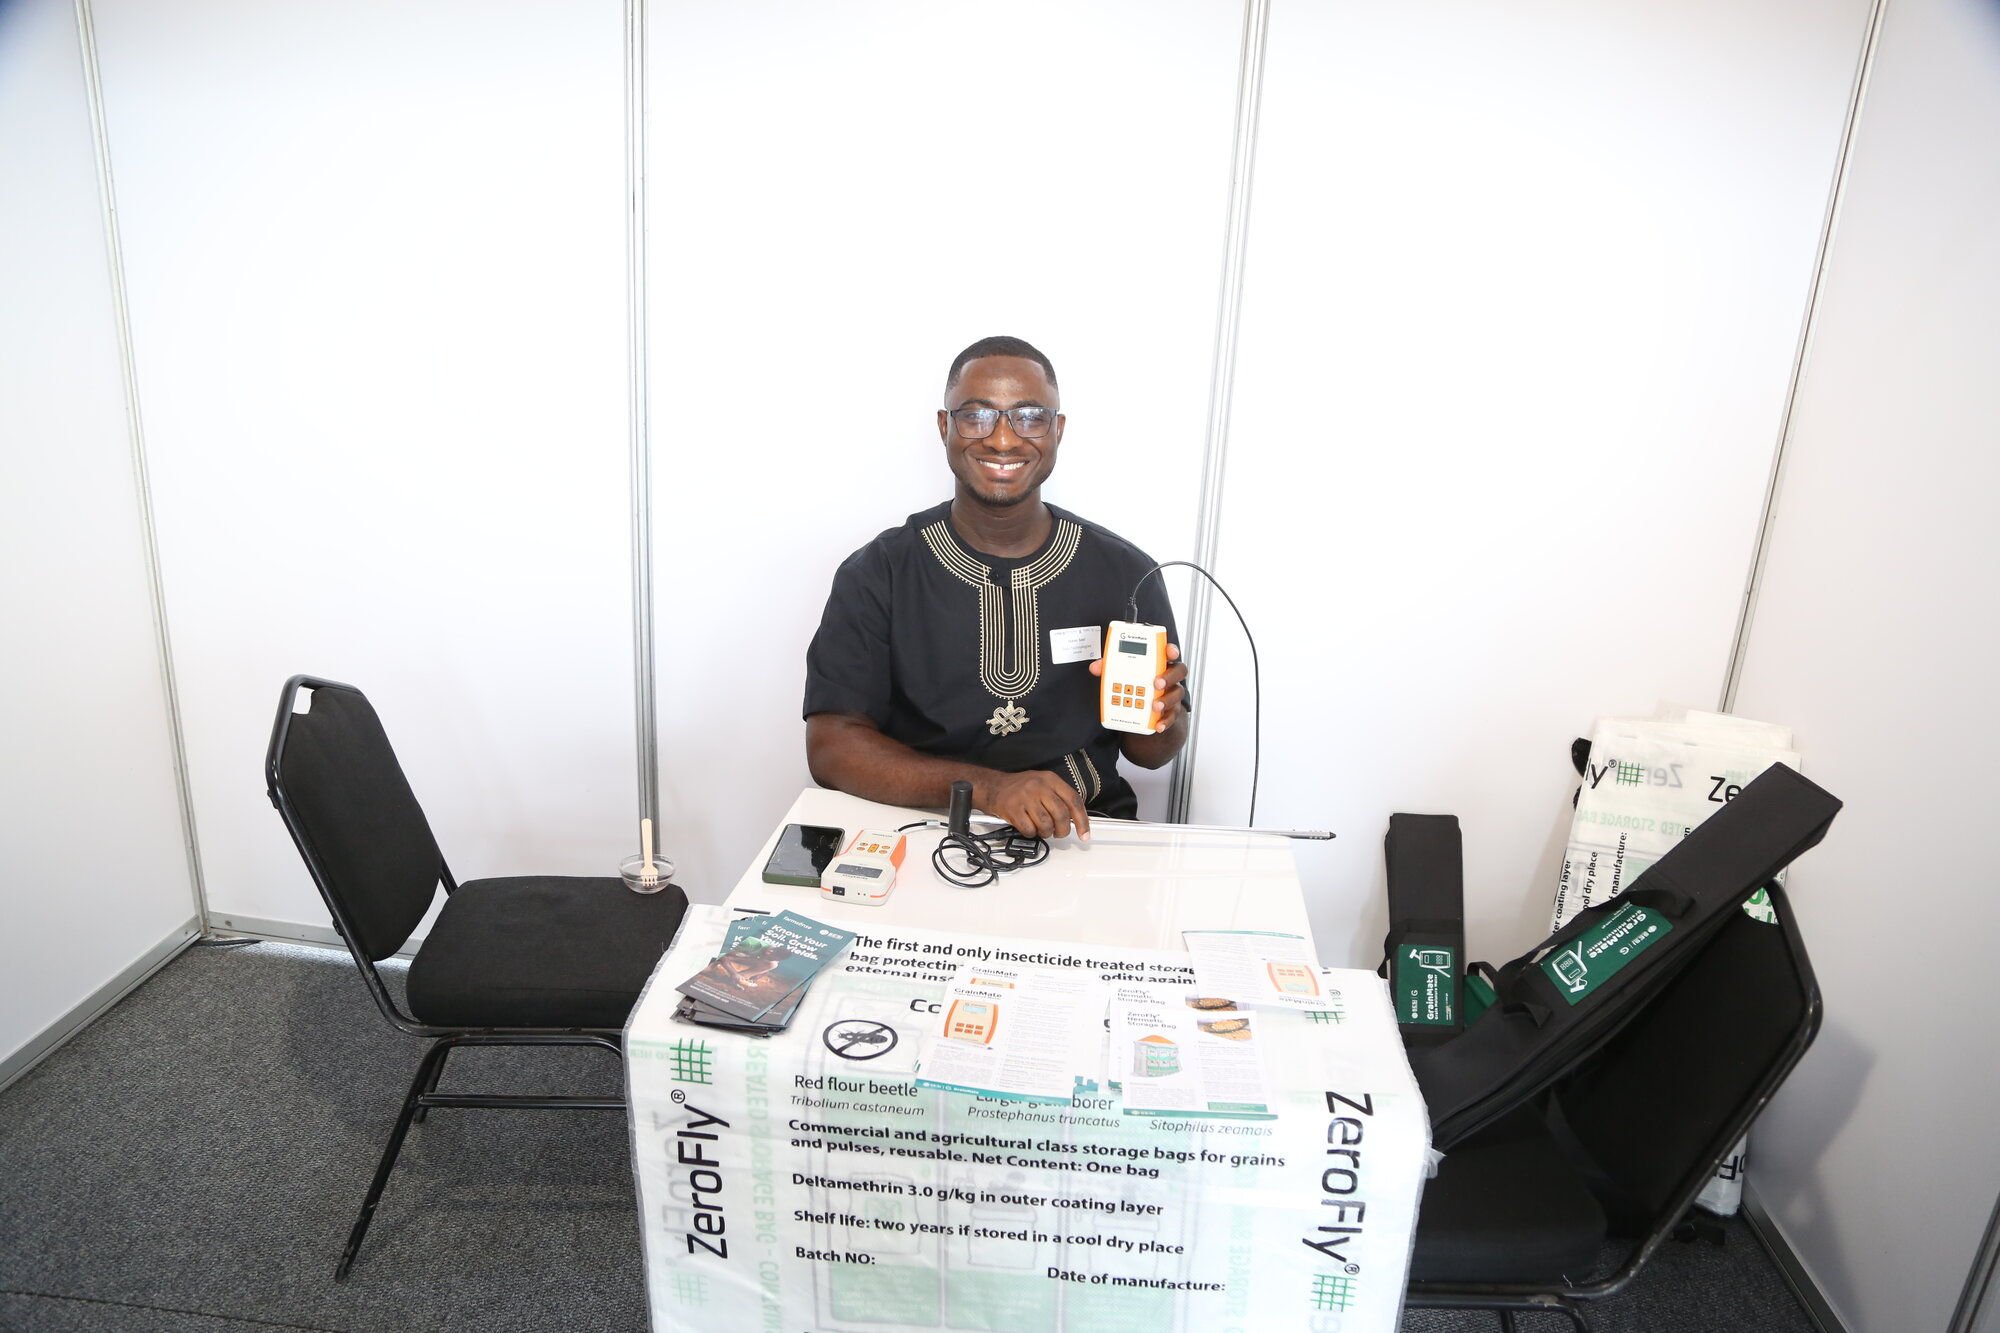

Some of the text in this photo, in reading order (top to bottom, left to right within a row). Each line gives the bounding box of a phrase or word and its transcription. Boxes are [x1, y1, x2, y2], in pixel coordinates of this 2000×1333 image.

[1707, 775, 1742, 803] Ze
[1611, 832, 1628, 895] manufacture:
[1582, 851, 1599, 910] ool dry place
[1552, 860, 1571, 934] ter coating layer
[759, 934, 785, 949] Your
[786, 944, 819, 961] Yields.
[764, 929, 818, 952] Soil. Grow
[771, 924, 828, 949] Know Your
[1588, 913, 1647, 959] GrainMate
[849, 951, 958, 972] bag protectin
[855, 935, 883, 949] The
[887, 938, 919, 952] first
[922, 944, 953, 956] and
[956, 947, 991, 961] only
[995, 948, 1082, 968] insecticide
[1086, 958, 1145, 972] treated
[845, 965, 917, 979] external
[971, 966, 1019, 977] GrainMate
[1099, 972, 1196, 985] odity again
[954, 987, 1003, 998] GrainMate
[1425, 974, 1435, 1020] GrainMate
[794, 1075, 918, 1098] Red flour beetle
[790, 1095, 925, 1116] Tribolium castaneum
[1072, 1095, 1115, 1111] borer
[967, 1106, 1121, 1128] Prostephanus truncatus
[1149, 1119, 1273, 1137] Sitophilus zeamais
[788, 1119, 1286, 1169] Commercial and agricultural class storage bags for grains
[790, 1137, 1160, 1180] and pulses, reusable. Net Content: One bag
[670, 1088, 731, 1260] ZeroFly®
[1301, 1090, 1374, 1276] ZeroFly®
[792, 1173, 1164, 1217] Deltamethrin 3.0 g/kg in outer coating layer
[793, 1209, 1185, 1256] Shelf life: two years if stored in a cool dry place
[795, 1246, 876, 1265] Batch NO:
[1047, 1266, 1226, 1292] Date of manufacture:
